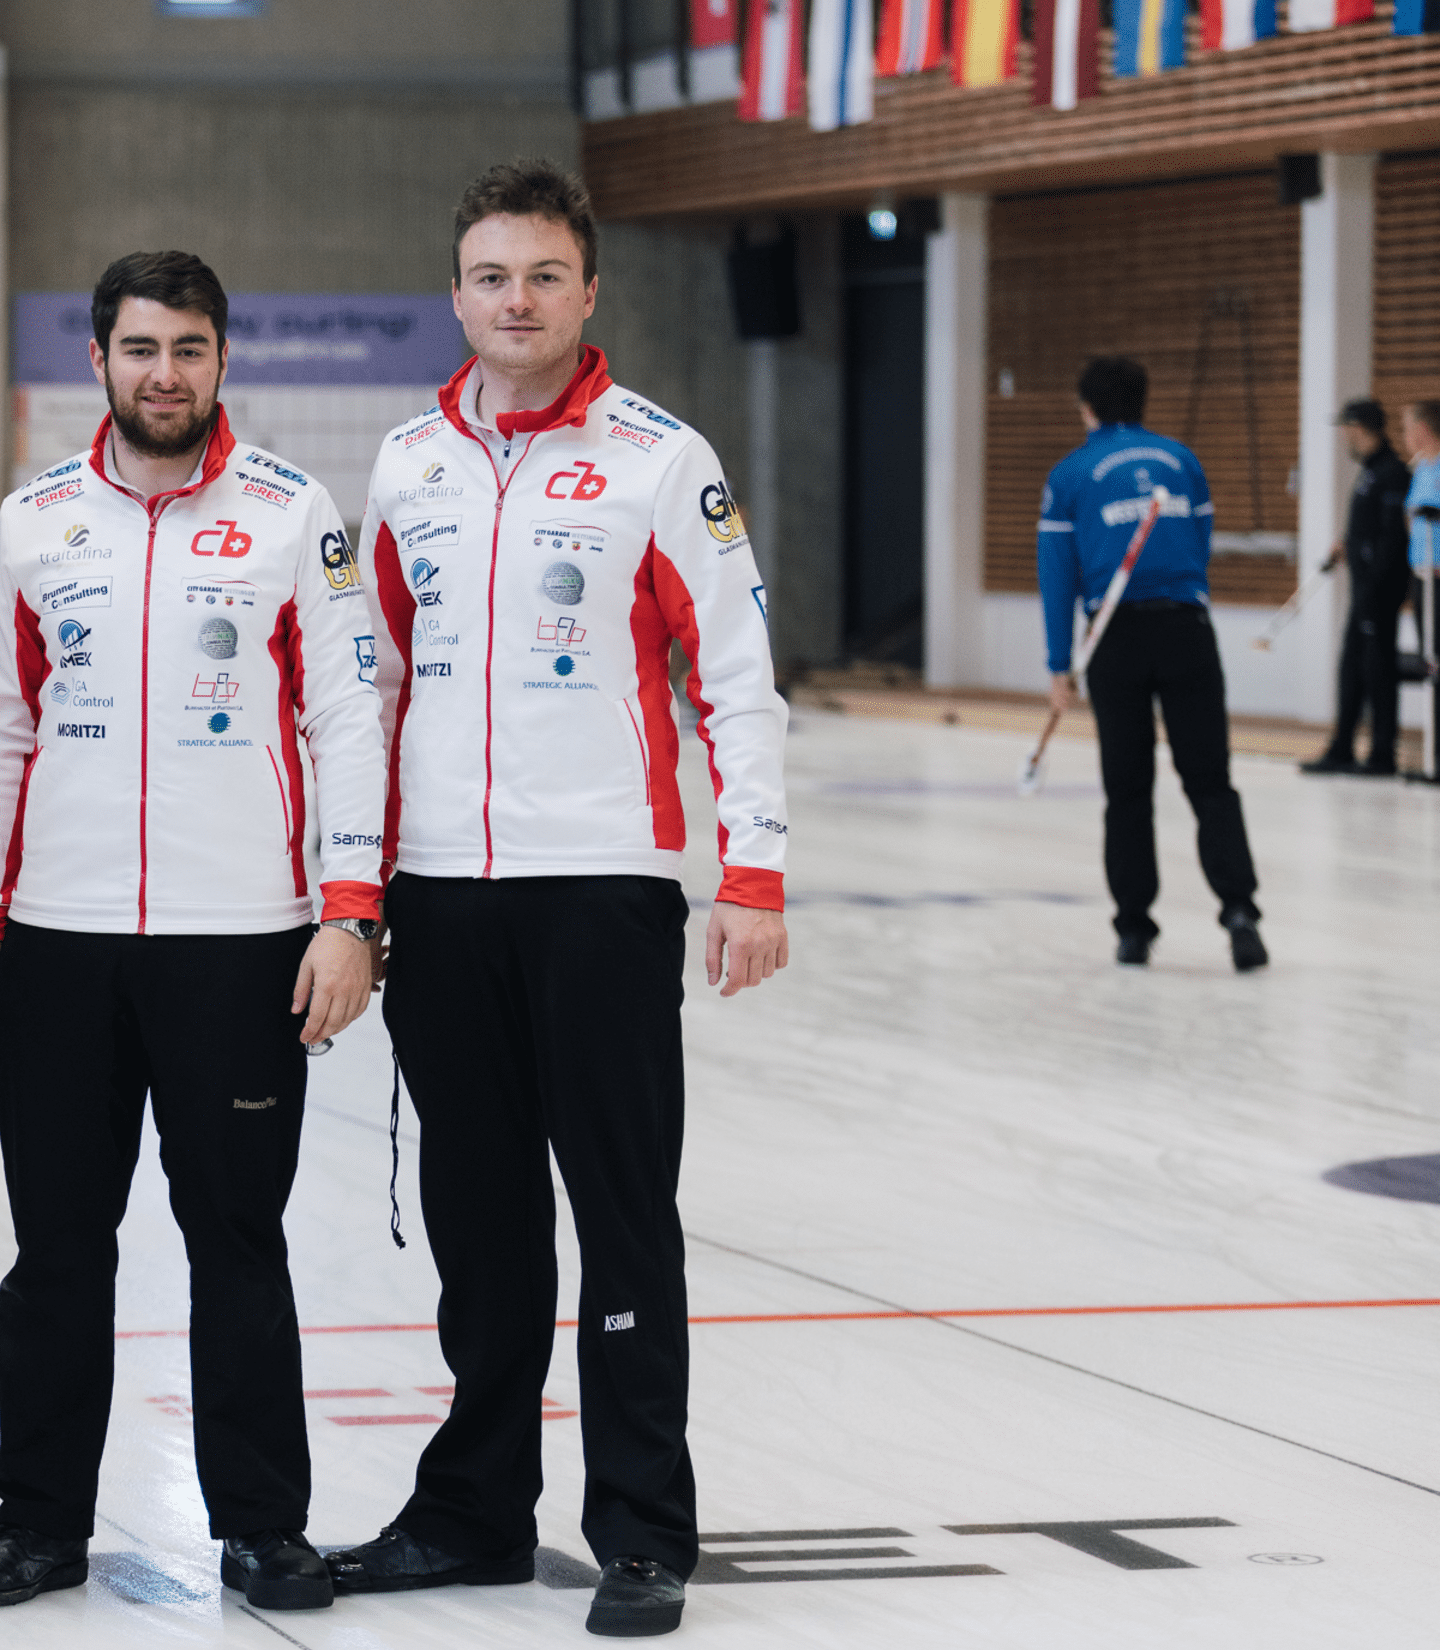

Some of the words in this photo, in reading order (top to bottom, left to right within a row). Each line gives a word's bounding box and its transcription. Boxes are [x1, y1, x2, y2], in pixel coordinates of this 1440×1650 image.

[619, 420, 664, 440] SECURITAS
[34, 478, 82, 498] SECURITAS
[249, 476, 296, 497] SECURITAS
[399, 484, 464, 502] traitafina
[401, 520, 432, 540] Brunner
[407, 524, 458, 548] Consulting
[39, 546, 112, 566] traitafina
[42, 582, 78, 602] Brunner
[51, 586, 108, 609] Consulting
[75, 680, 87, 692] GA
[73, 695, 114, 707] Control
[57, 723, 105, 739] MORITZI
